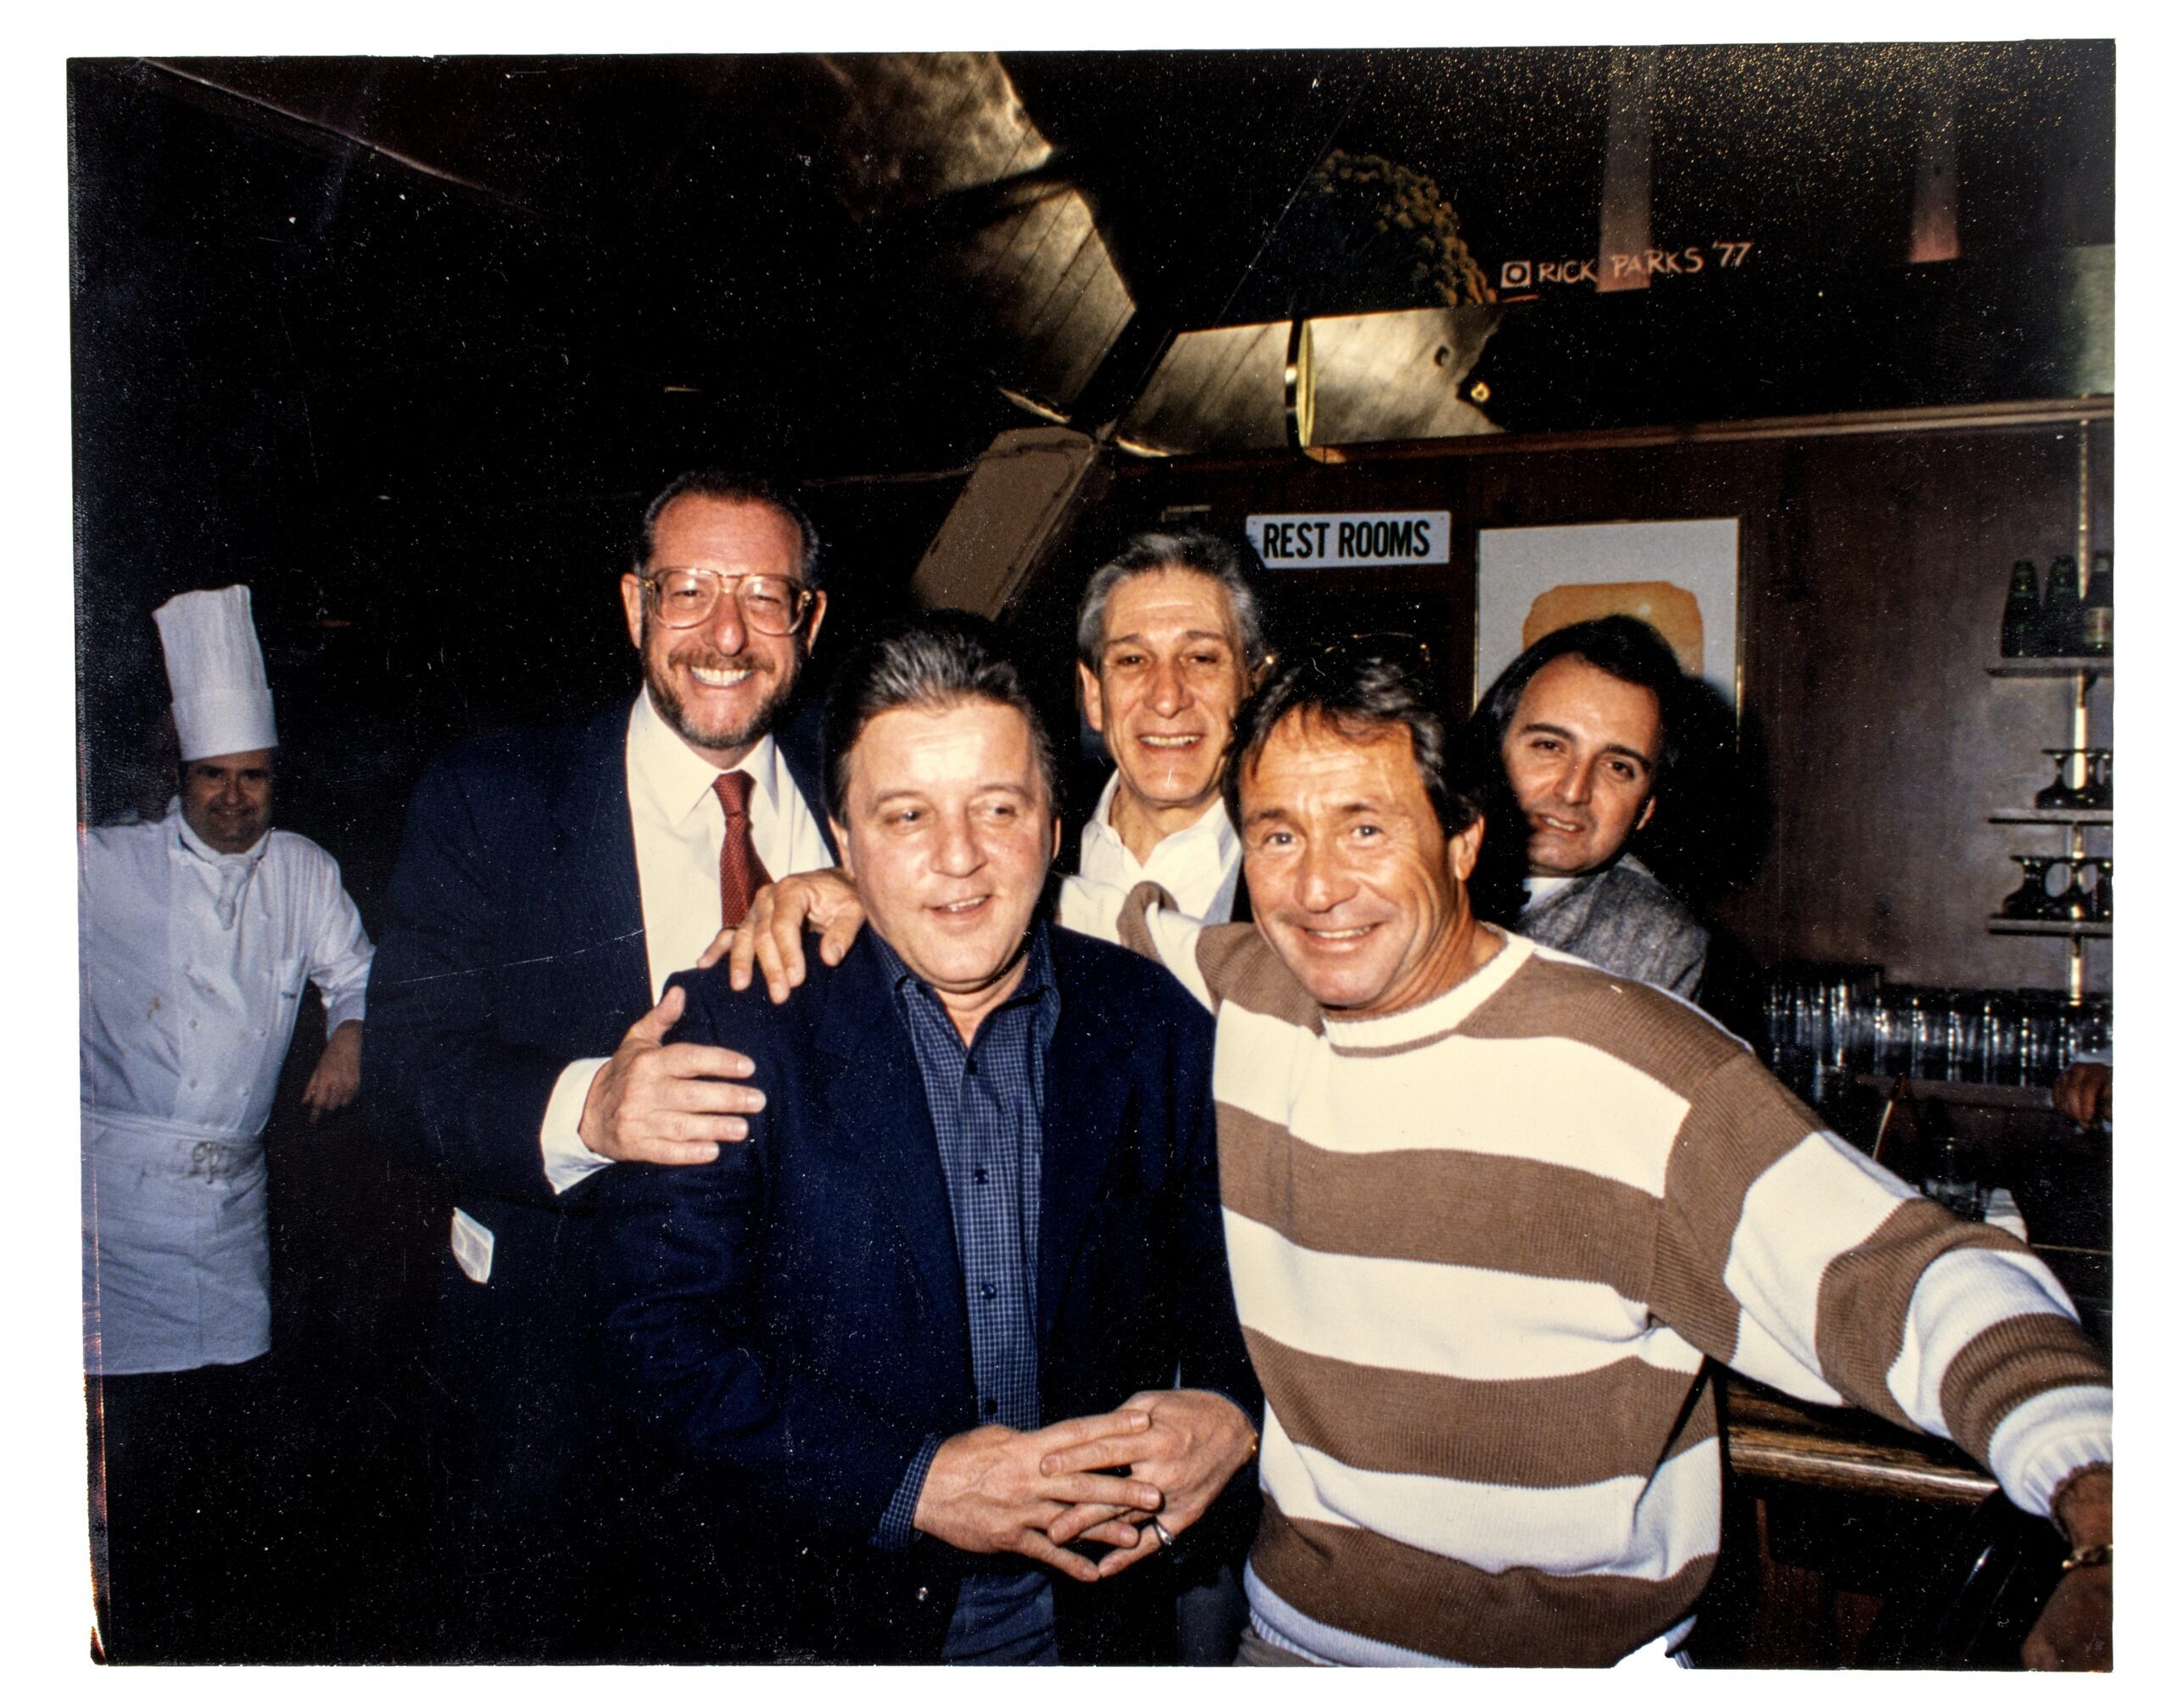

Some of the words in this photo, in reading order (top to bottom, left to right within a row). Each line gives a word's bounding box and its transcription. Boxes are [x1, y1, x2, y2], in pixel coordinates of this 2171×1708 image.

[1538, 260, 1598, 283] RICK
[1613, 246, 1705, 278] PARKS
[1264, 522, 1331, 558] REST
[1338, 521, 1431, 557] ROOMS
